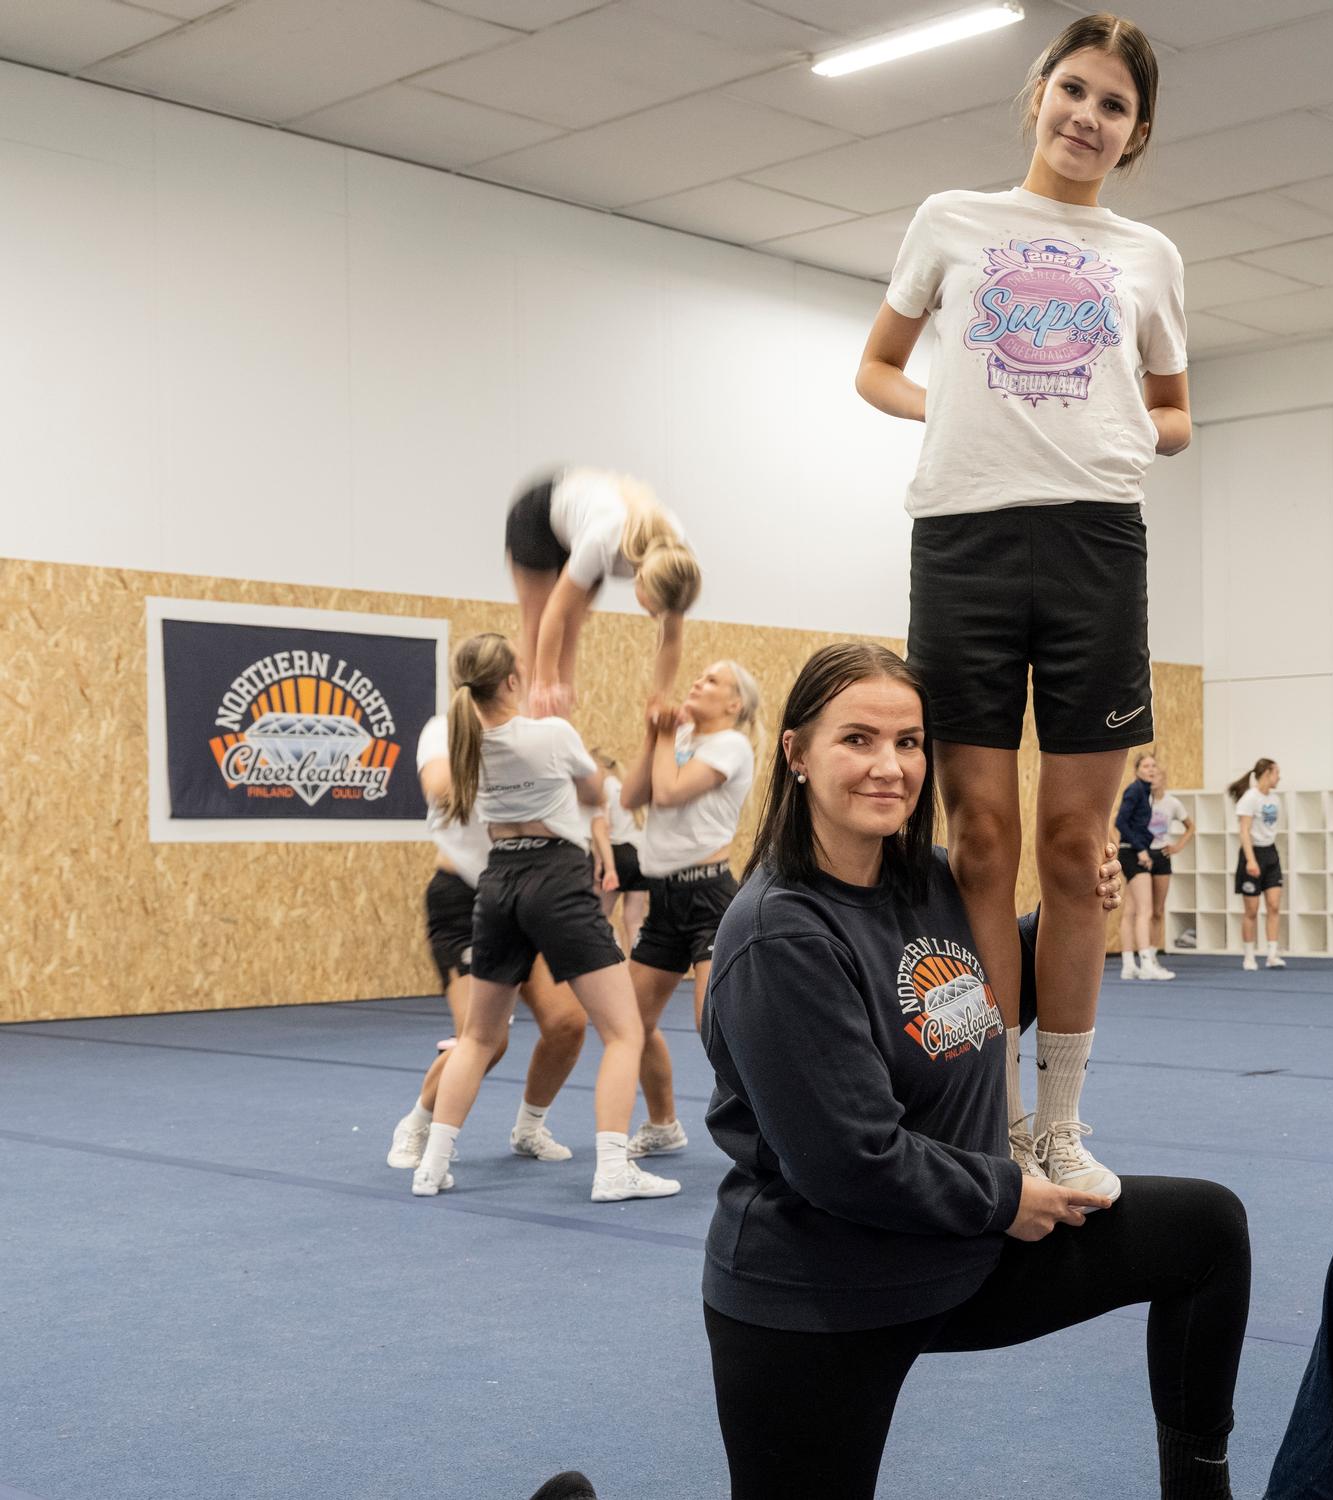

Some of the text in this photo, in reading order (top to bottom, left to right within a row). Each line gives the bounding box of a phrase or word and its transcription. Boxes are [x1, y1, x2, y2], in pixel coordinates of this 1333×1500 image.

[1028, 252, 1080, 267] 2024
[1009, 271, 1091, 297] CHEERLEADING
[969, 287, 1120, 348] Super
[1003, 337, 1079, 363] CHEERDANCE
[1069, 330, 1121, 346] 3&4&5
[215, 650, 396, 737] NORTHERN LIGHTS
[221, 743, 391, 801] Cheerleading
[247, 785, 361, 799] FINLAND OULU
[678, 865, 718, 882] NIKE
[931, 937, 984, 982] LIGHTS
[921, 1000, 1003, 1056] Cheerleading
[944, 1043, 971, 1061] FINLAND
